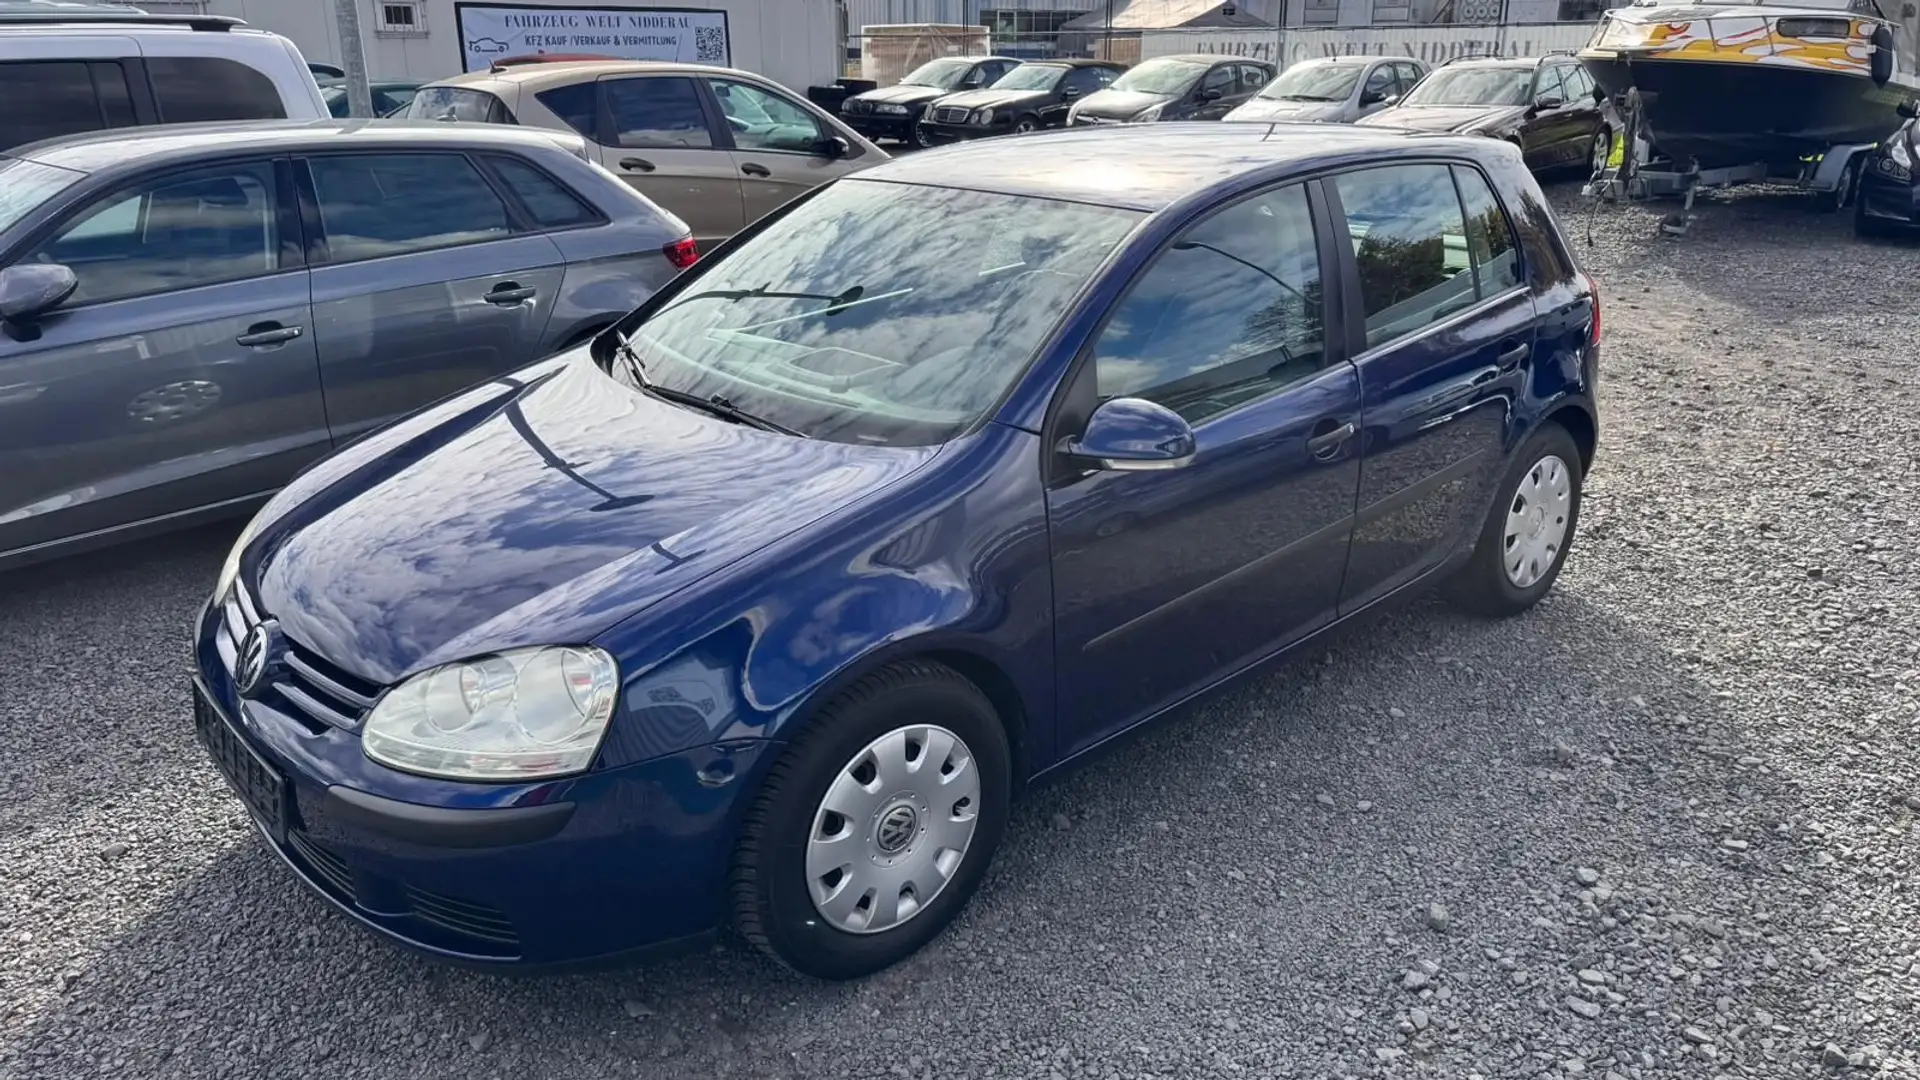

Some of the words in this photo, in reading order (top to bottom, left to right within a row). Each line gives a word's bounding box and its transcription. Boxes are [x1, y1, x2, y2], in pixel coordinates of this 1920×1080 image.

[504, 15, 579, 28] FAHRZEUG
[586, 16, 621, 28] WELT
[629, 16, 692, 29] NIDDERAU
[525, 34, 542, 46] KFZ
[545, 35, 568, 46] KAUF
[613, 35, 621, 46] &
[623, 35, 677, 46] VERMITTLUNG
[1322, 42, 1389, 57] WELT
